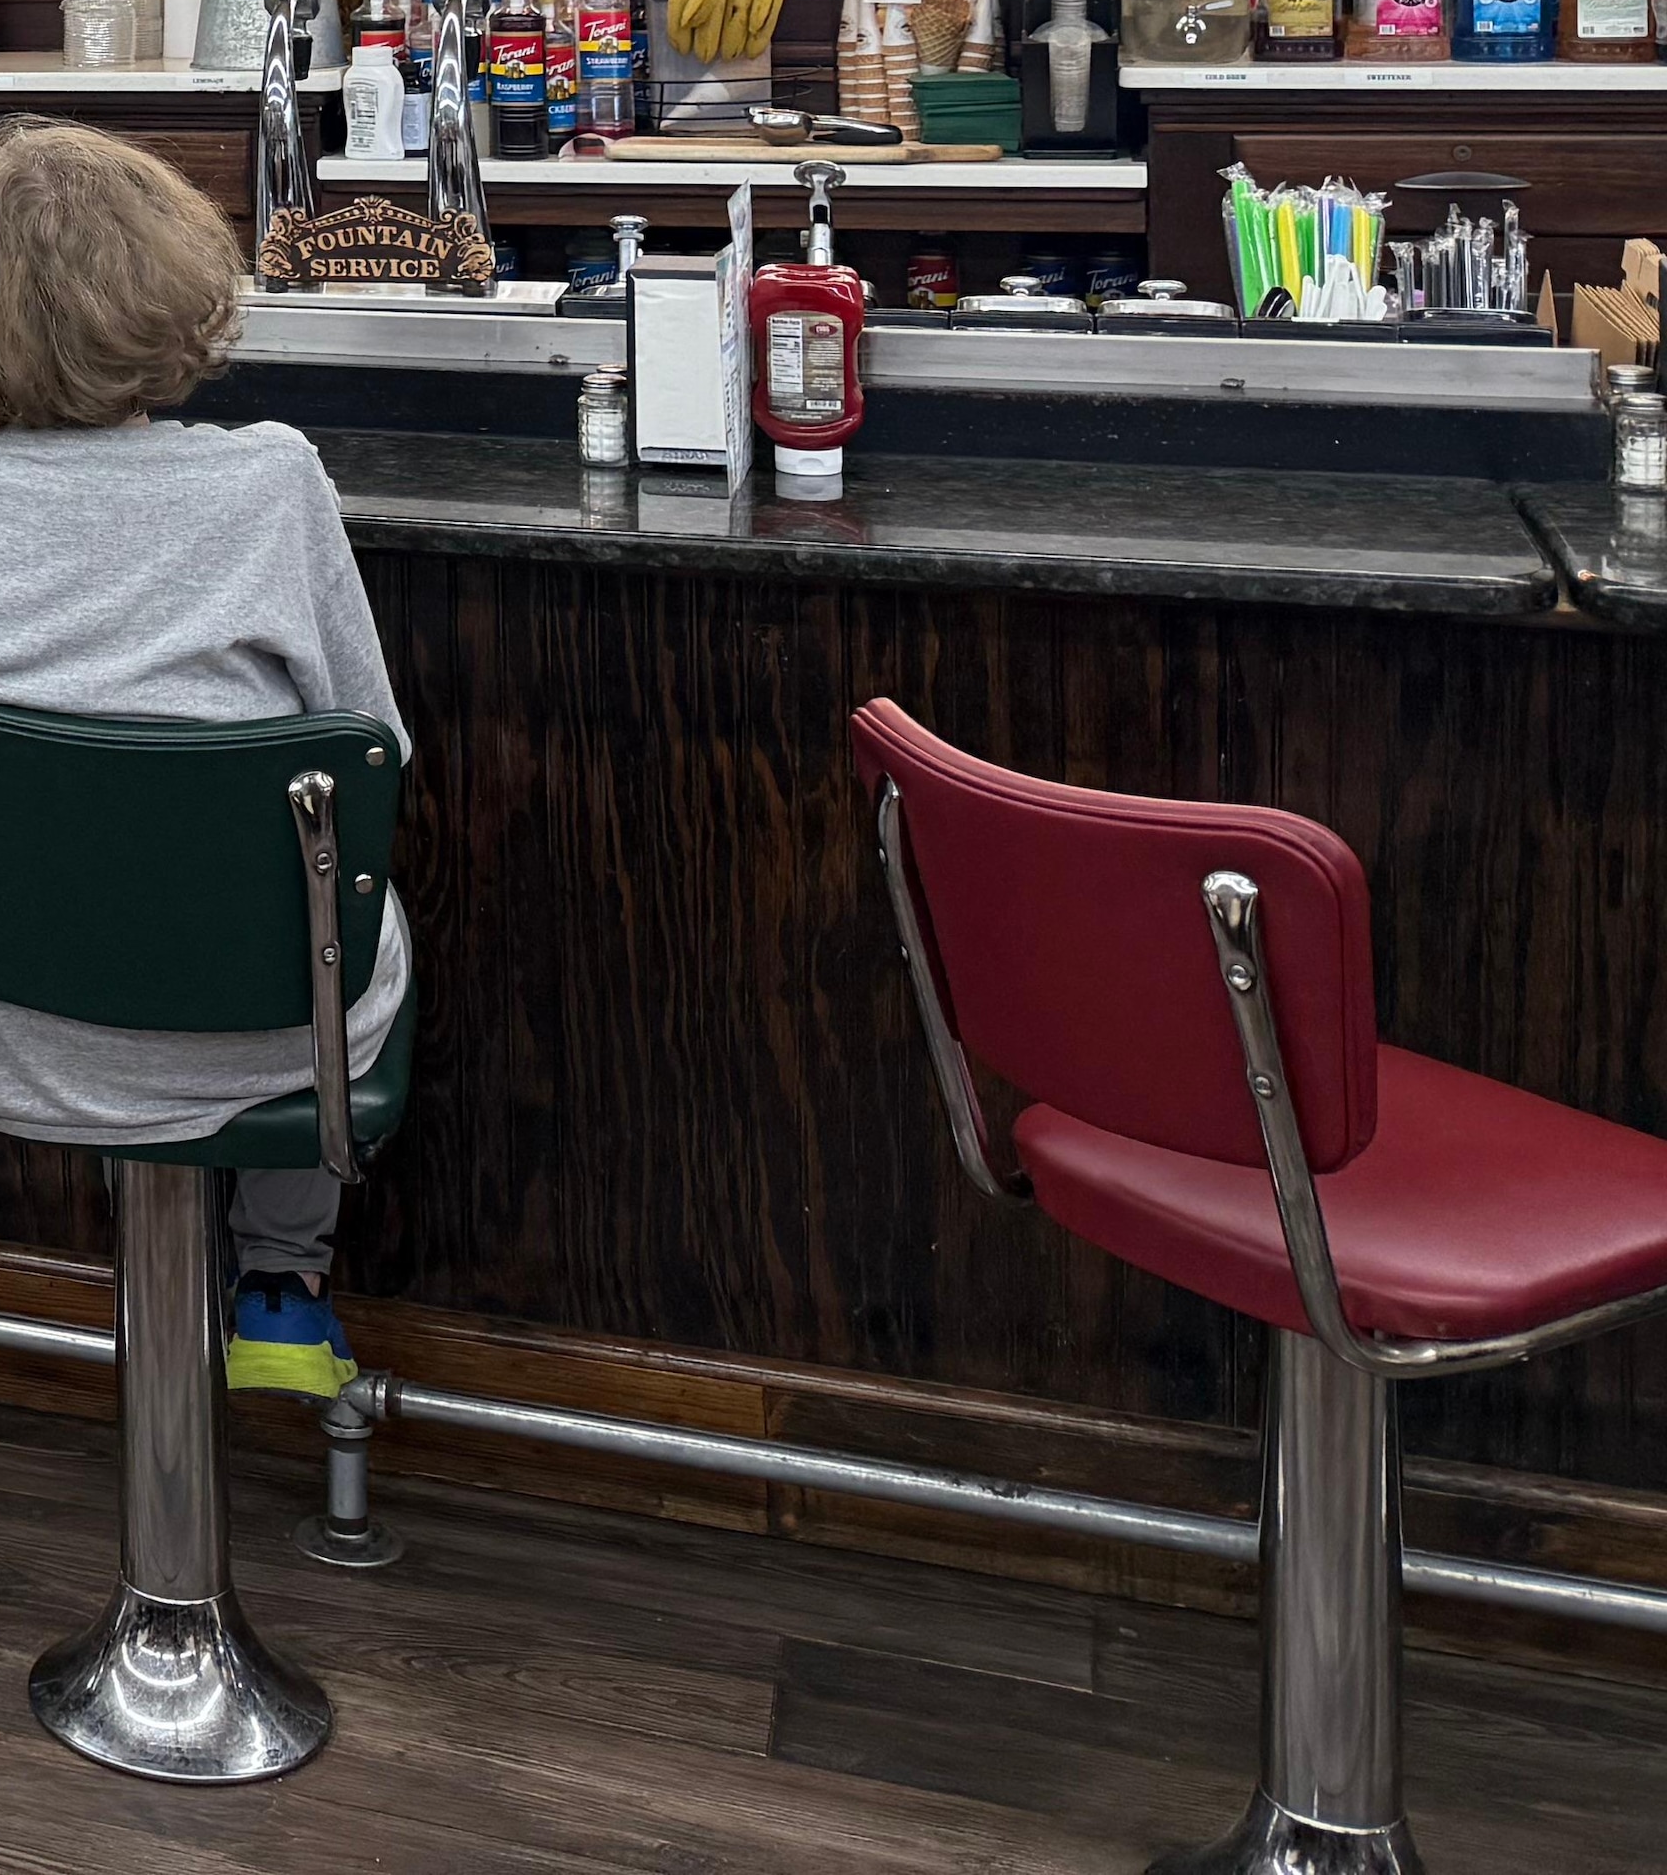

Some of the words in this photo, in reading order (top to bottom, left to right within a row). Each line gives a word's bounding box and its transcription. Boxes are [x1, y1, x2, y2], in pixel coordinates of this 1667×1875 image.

[584, 18, 627, 42] Torani
[494, 42, 537, 65] Torani
[496, 82, 535, 92] RASPBERRY
[295, 225, 455, 261] FOUNTAIN
[309, 258, 441, 279] SERVICE
[568, 266, 616, 293] Torani
[1086, 269, 1139, 289] Torani
